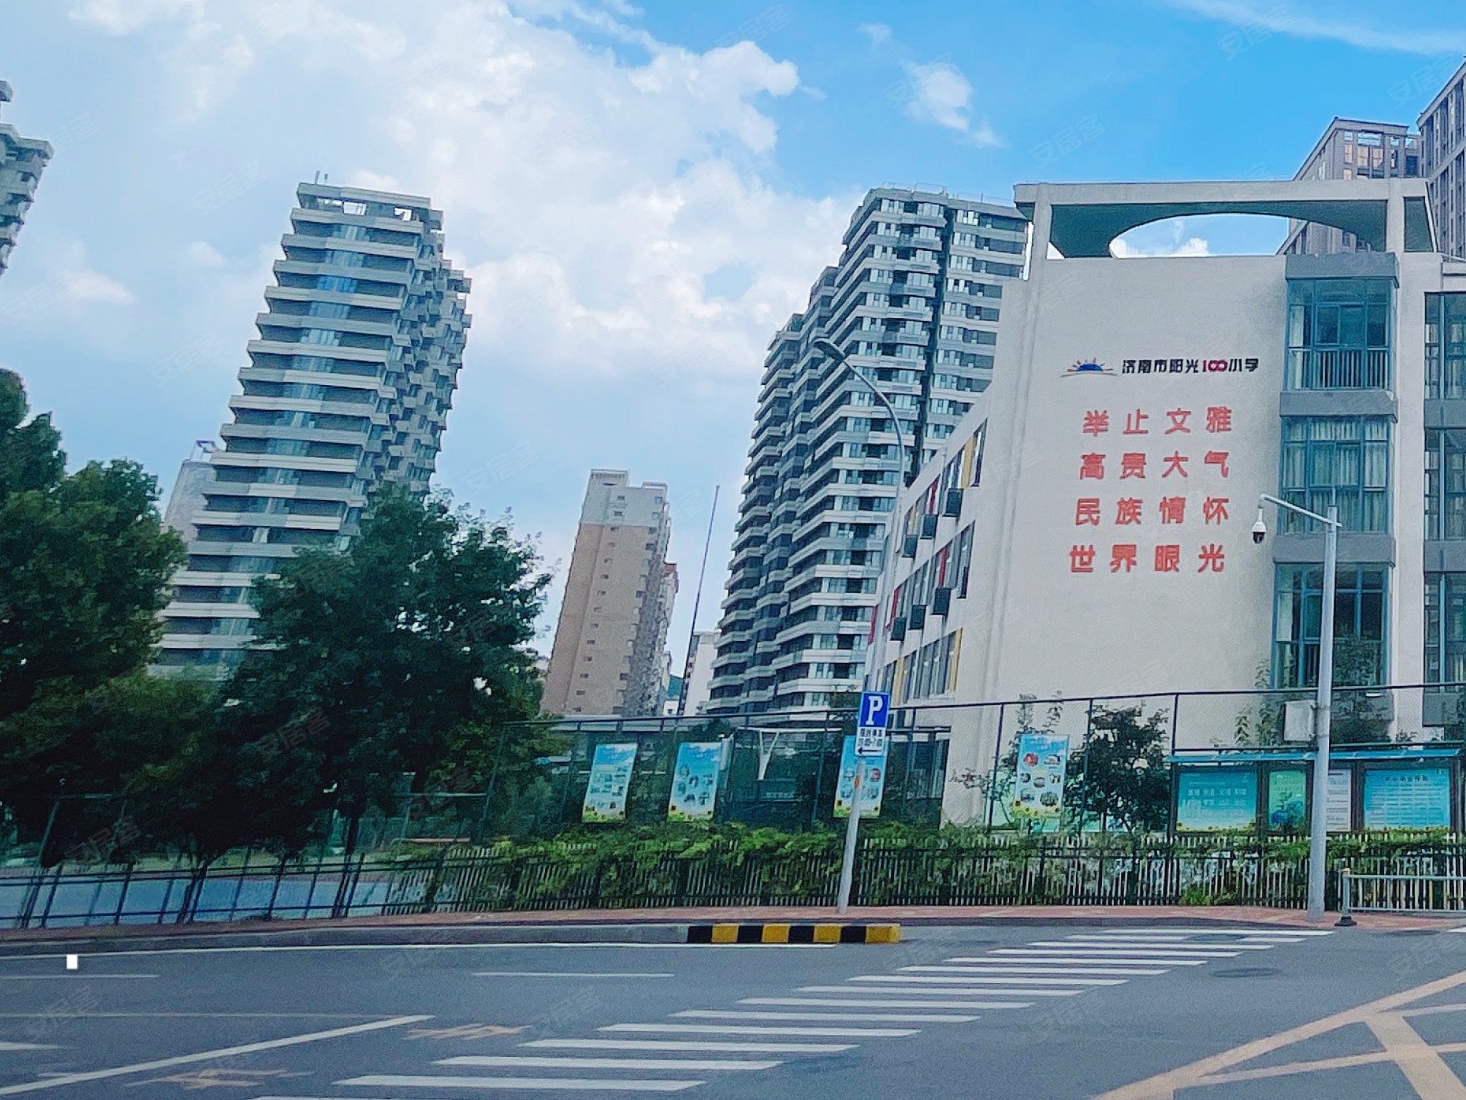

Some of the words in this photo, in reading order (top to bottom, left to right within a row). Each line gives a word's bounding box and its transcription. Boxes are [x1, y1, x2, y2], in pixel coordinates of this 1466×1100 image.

[1122, 358, 1259, 374] 济南市阳光100小学
[1083, 406, 1232, 436] 举止文雅
[1079, 450, 1230, 480] 高贵大气
[1074, 496, 1230, 526] 民族情怀
[1069, 543, 1226, 573] 世界眼光
[865, 695, 883, 726] P
